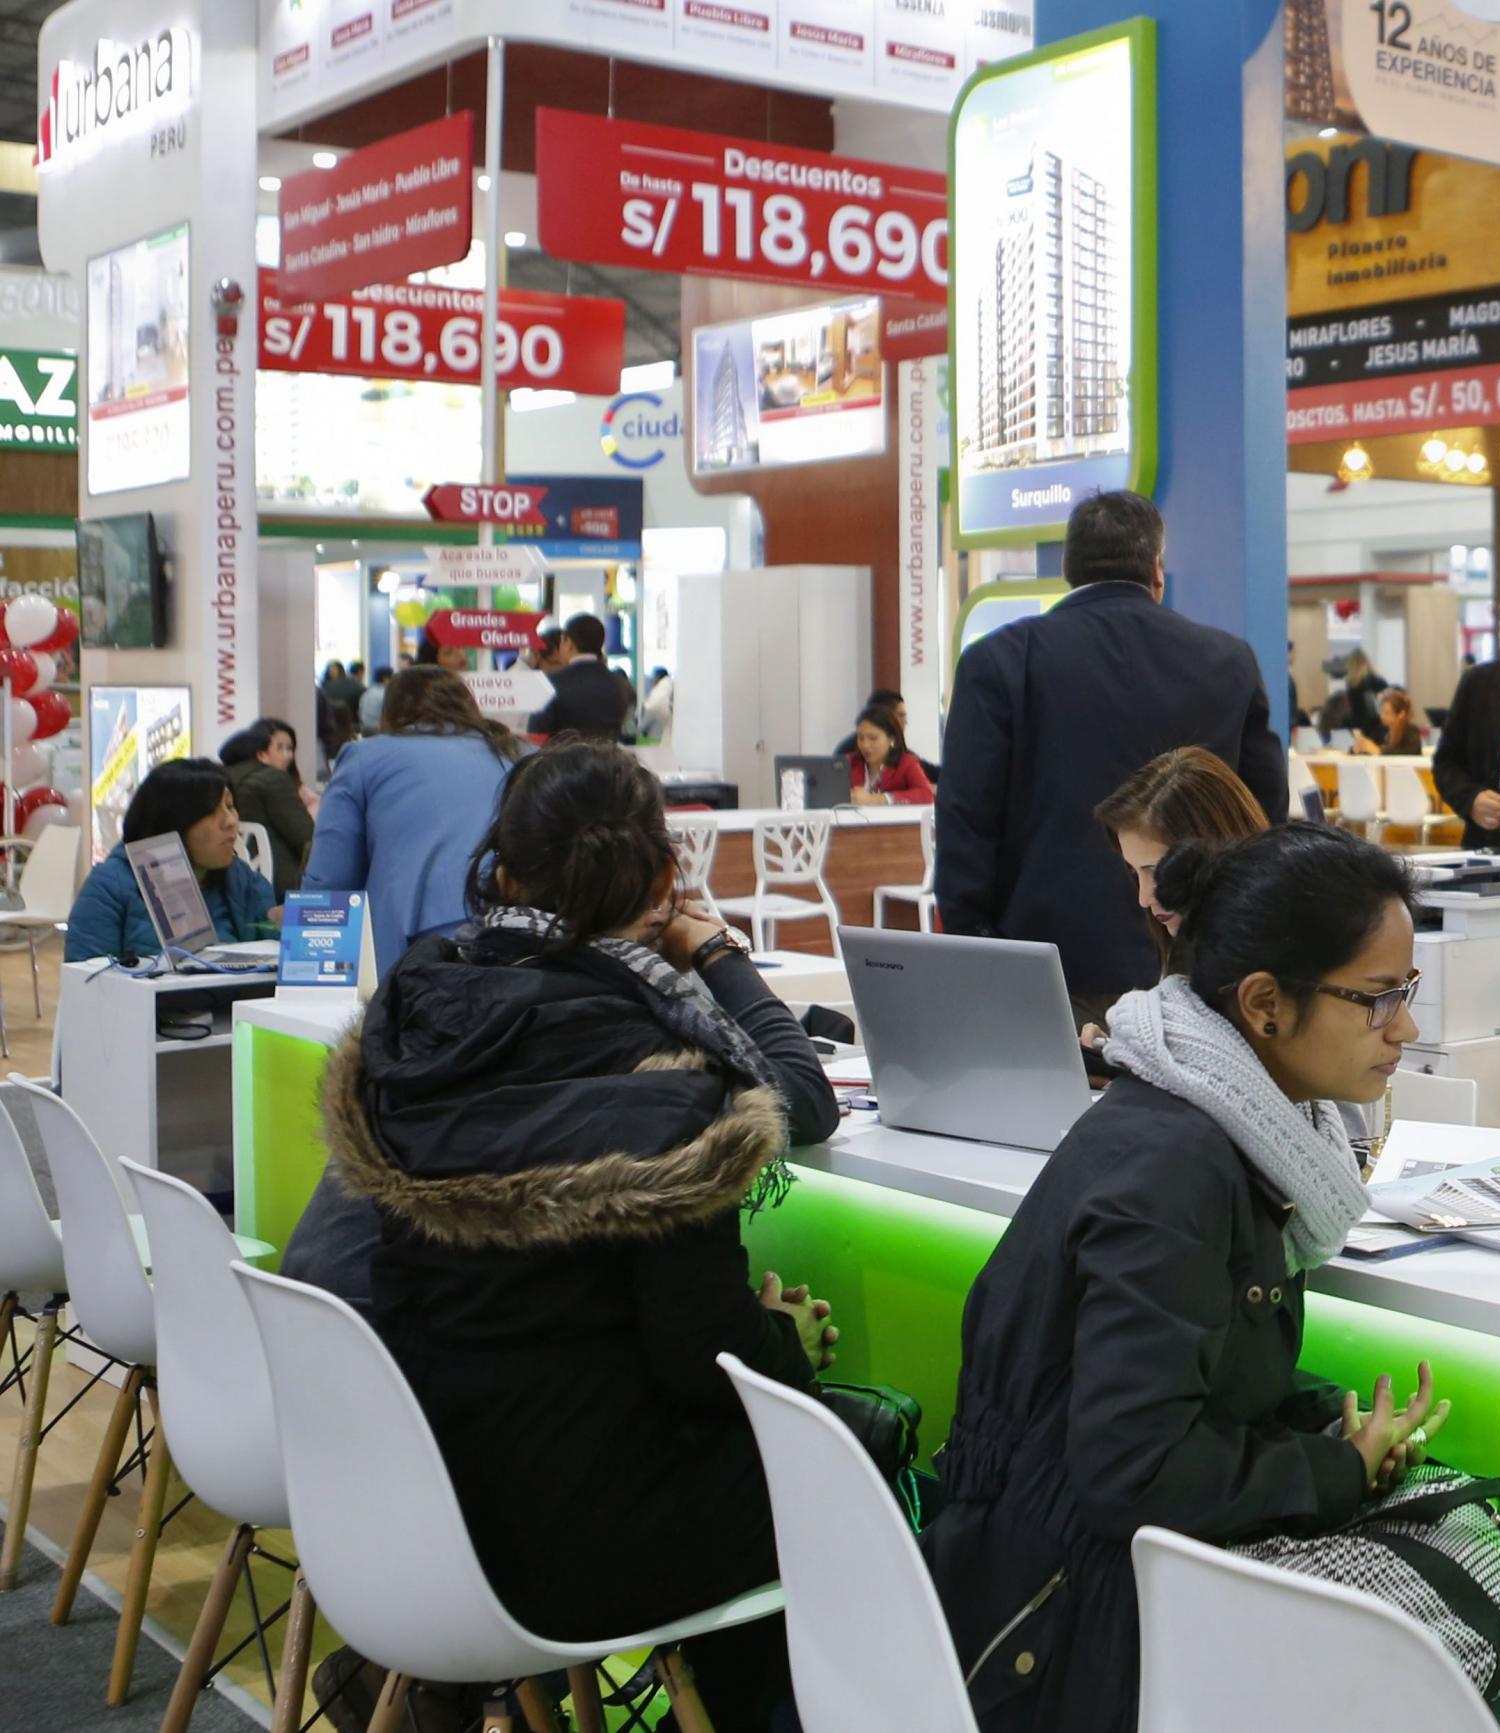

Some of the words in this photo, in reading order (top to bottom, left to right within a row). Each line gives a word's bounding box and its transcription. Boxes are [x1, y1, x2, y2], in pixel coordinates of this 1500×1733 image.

[1370, 0, 1412, 51] 12
[1416, 35, 1468, 66] AÑOS
[1473, 51, 1497, 74] DE
[64, 28, 174, 143] urbana
[1376, 50, 1497, 97] EXPERIENCIA
[395, 164, 431, 193] Pueblo
[431, 157, 460, 181] Libre
[620, 170, 640, 187] De
[642, 174, 682, 194] hasta
[723, 148, 882, 197] Descuentos
[1290, 315, 1393, 349] MIRAFLORES
[1364, 340, 1419, 369] JESUS
[1422, 329, 1480, 360] MARÍA
[1353, 399, 1406, 422] HASTA
[0, 424, 80, 445] MOBILI
[622, 413, 684, 438] ciud
[460, 487, 531, 520] STOP
[1011, 485, 1072, 511] Surquillo
[211, 336, 241, 725] www.urbanaperu.com.pe
[496, 545, 508, 561] lo
[449, 568, 473, 581] que
[477, 567, 522, 578] buscas
[450, 611, 507, 628] Grandes
[480, 629, 529, 646] Ofertas
[479, 692, 516, 707] depa
